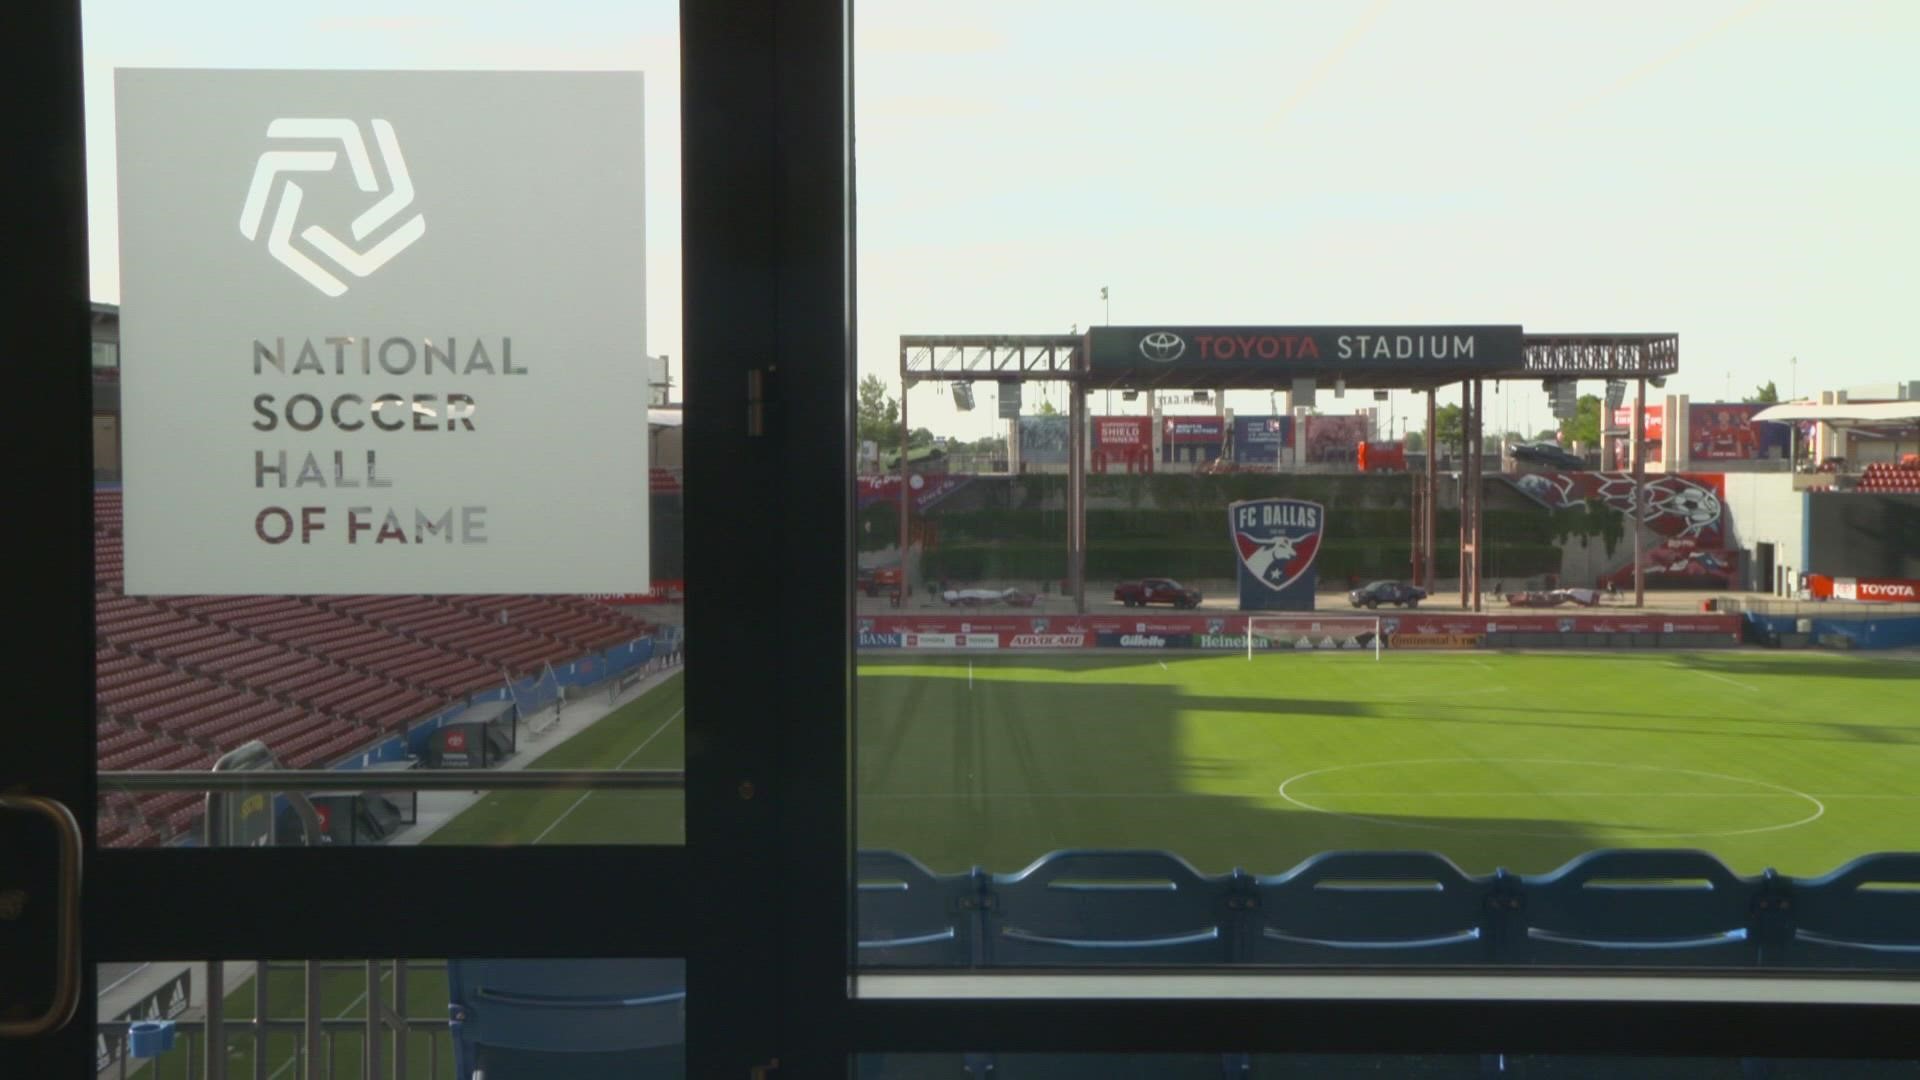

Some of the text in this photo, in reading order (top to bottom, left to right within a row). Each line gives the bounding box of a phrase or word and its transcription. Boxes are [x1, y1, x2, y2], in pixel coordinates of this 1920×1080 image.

[253, 337, 528, 375] NATIONAL
[1197, 335, 1475, 359] TOYOTA STADIUM
[252, 393, 476, 432] SOCCER
[1101, 427, 1139, 436] SHIELD
[255, 450, 392, 487] HALL
[255, 506, 488, 544] OF FAME
[1239, 505, 1316, 528] FC DALLAS
[1860, 583, 1915, 597] TOYOTA
[859, 633, 897, 645] BANK
[1119, 634, 1166, 647] Gillette
[1200, 634, 1268, 648] Heineken
[1391, 633, 1449, 648] Continental
